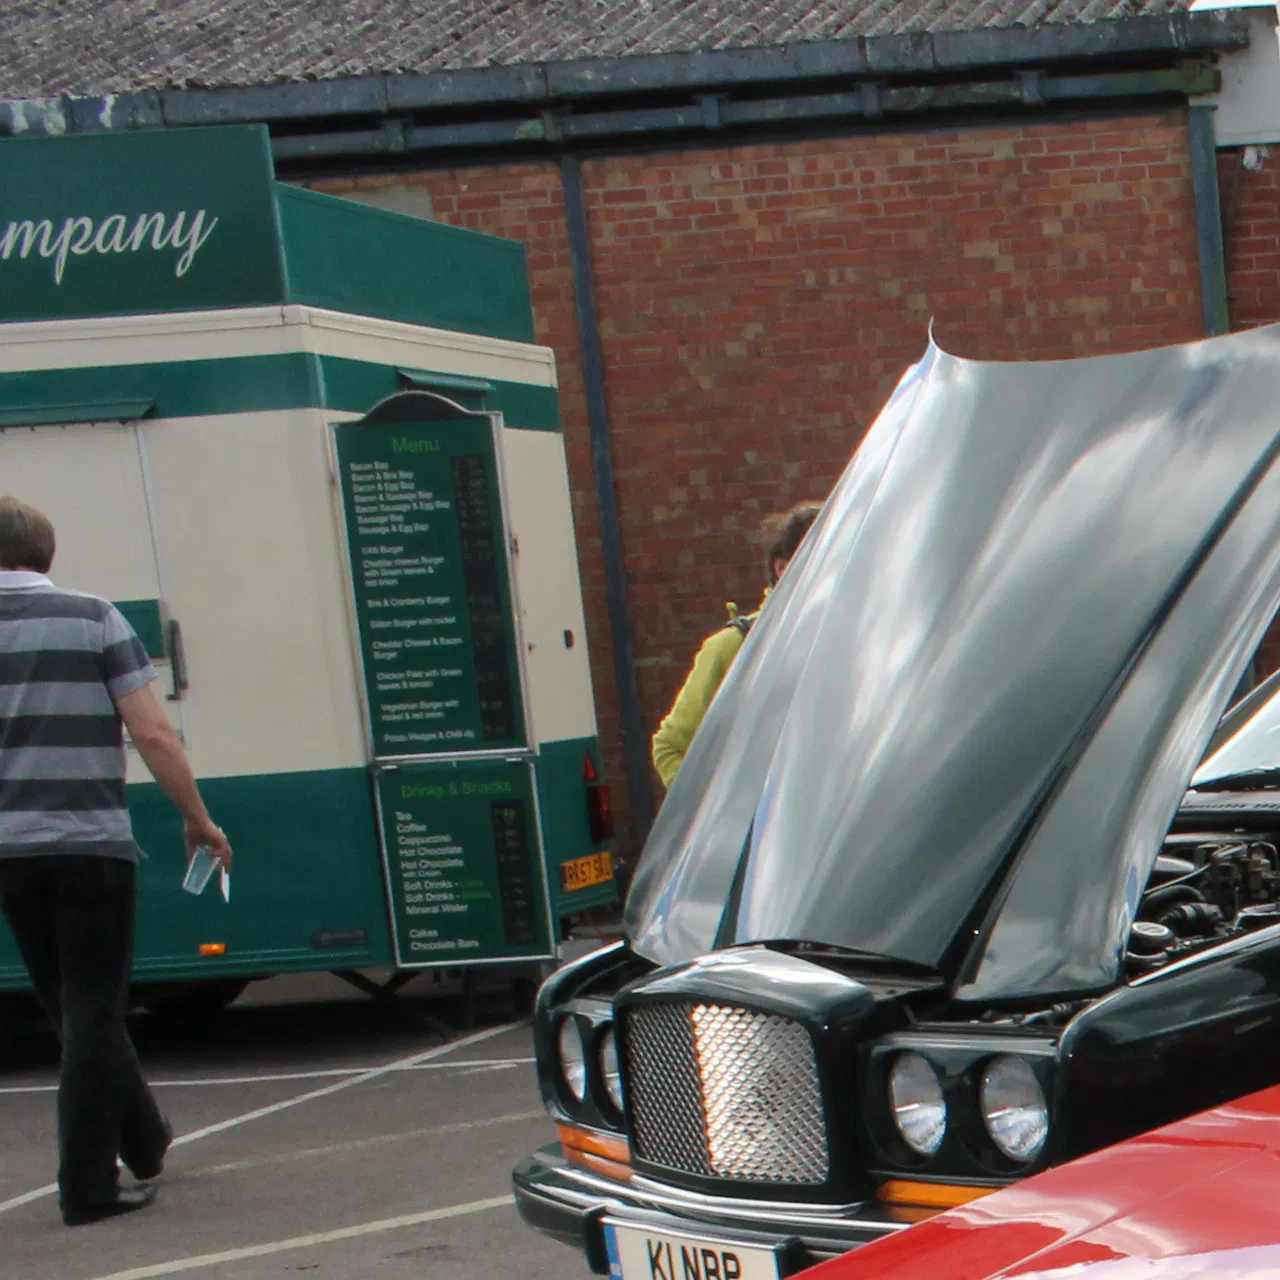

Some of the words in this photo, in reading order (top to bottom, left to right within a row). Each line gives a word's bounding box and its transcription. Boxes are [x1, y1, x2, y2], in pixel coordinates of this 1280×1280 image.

[392, 437, 440, 453] Menu
[402, 785, 444, 798] Drinks
[463, 781, 512, 795] Snacks
[397, 823, 427, 833] Coffee
[399, 847, 416, 857] Hot
[418, 845, 463, 856] Chocolate
[401, 860, 417, 869] Hot
[419, 858, 464, 869] Chocolate
[404, 881, 422, 891] Soft
[425, 880, 453, 890] Drinks
[405, 894, 423, 903] Soft
[426, 892, 454, 902] Drinks
[407, 906, 440, 915] Mineral
[442, 904, 468, 913] Water
[410, 929, 439, 938] Cakes
[411, 941, 456, 951] Chocolate
